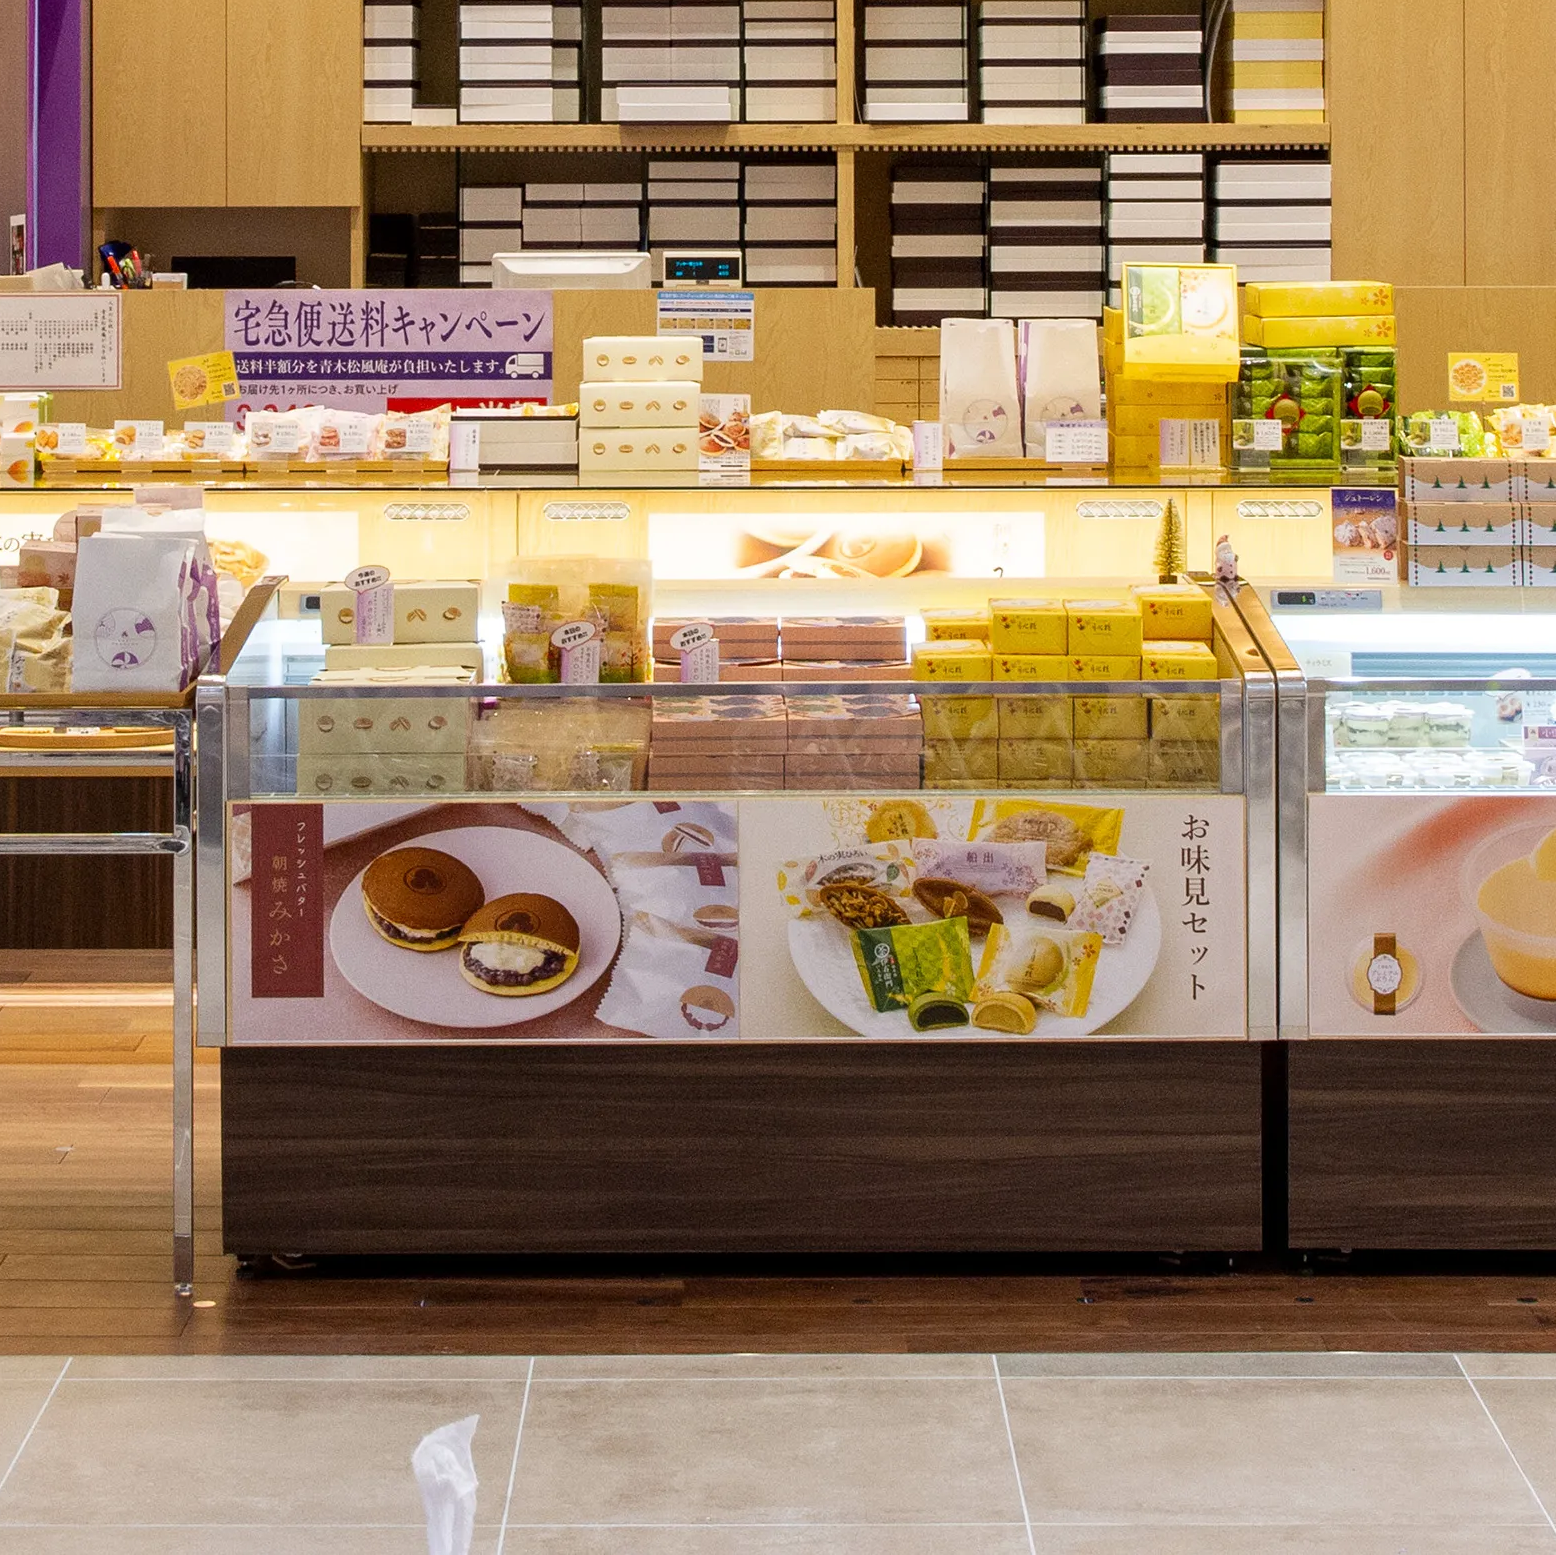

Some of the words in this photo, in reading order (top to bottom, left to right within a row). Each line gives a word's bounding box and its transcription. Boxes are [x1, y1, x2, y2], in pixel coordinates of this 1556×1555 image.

[234, 299, 545, 347] 宅急便送料キャンペーン
[236, 359, 505, 374] 送料半額分を青木松風庵が負担いたします。
[296, 822, 307, 917] フレッシュバター
[1180, 814, 1211, 1001] お味見セット
